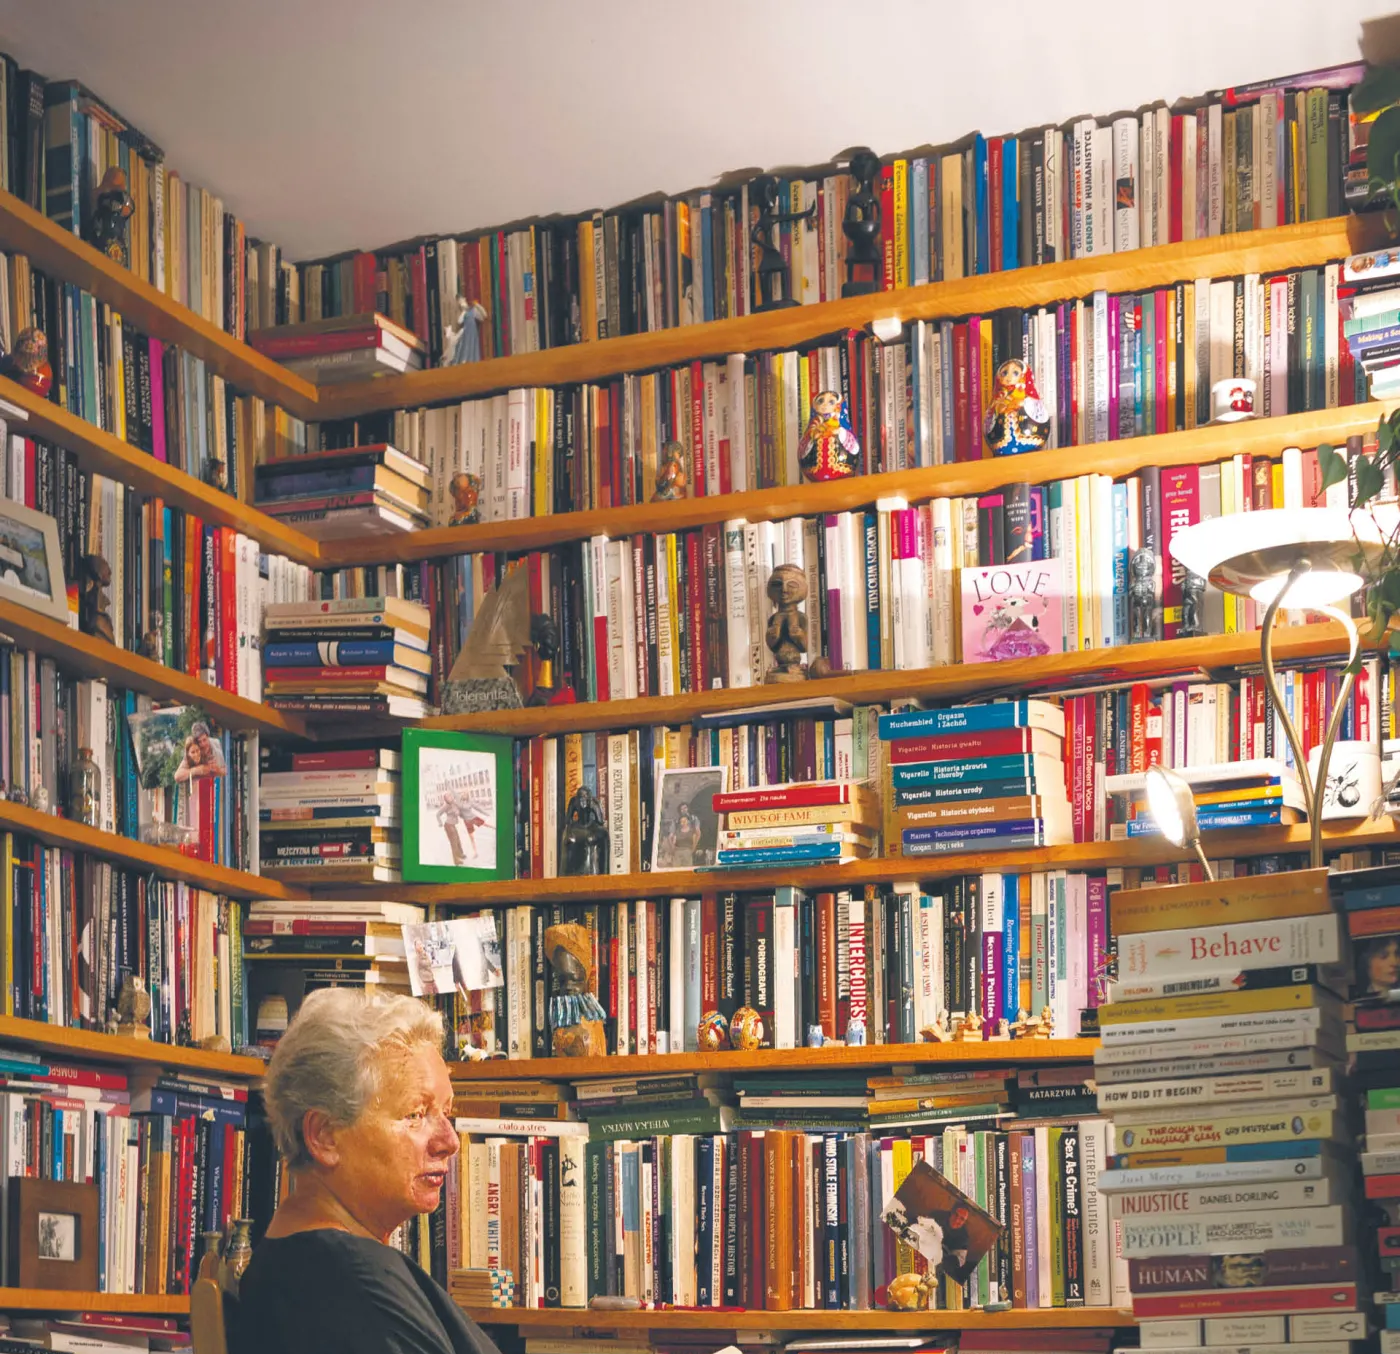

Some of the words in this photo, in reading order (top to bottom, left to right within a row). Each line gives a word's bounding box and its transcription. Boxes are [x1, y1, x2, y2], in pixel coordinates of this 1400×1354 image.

[1084, 130, 1092, 199] HUMANISTYCE
[1085, 202, 1092, 210] W
[1085, 214, 1093, 253] GENDER
[1288, 275, 1296, 305] Zdrowie
[1236, 297, 1244, 320] WOMEN
[1288, 307, 1296, 335] kobiety
[867, 527, 877, 564] WOMEN
[867, 566, 878, 591] WHO
[972, 569, 1050, 602] LOVE
[610, 574, 621, 626] Anatomy
[868, 590, 878, 612] KILL
[659, 602, 670, 657] PEDOFILIA
[613, 644, 622, 673] Love
[890, 718, 933, 728] Muchembled
[938, 713, 965, 721] Orgazm
[942, 719, 967, 728] Zachód
[1134, 703, 1143, 734] WOMEN
[613, 740, 622, 764] STEINEM
[898, 744, 927, 754] Vigarello
[931, 742, 958, 750] Historia
[1086, 736, 1093, 744] In
[1134, 740, 1143, 767] AND
[900, 770, 929, 779] Vigarello
[961, 763, 987, 771] zdrowia
[938, 771, 964, 779] choroby
[1085, 753, 1093, 786] Different
[613, 769, 623, 811] REVOLUTION
[902, 791, 931, 800] Vigarello
[935, 788, 962, 796] Historia
[963, 786, 983, 795] urody
[1085, 788, 1093, 810] Voice
[614, 813, 623, 831] FROM
[733, 813, 765, 825] WIVES
[768, 812, 780, 823] OF
[907, 811, 937, 820] Vigarello
[941, 808, 967, 817] Historia
[1214, 815, 1252, 824] SHOWALTER
[614, 833, 624, 858] WITHIN
[935, 829, 969, 838] Technologia
[837, 891, 849, 940] WOMEN
[987, 891, 995, 926] Millett
[1006, 919, 1014, 953] Rewriting
[1035, 924, 1044, 954] female
[1190, 932, 1282, 961] Behave
[837, 942, 849, 972] WHO
[987, 936, 995, 974] Sexual
[757, 938, 766, 1006] PORNOGRAPHY
[1036, 957, 1044, 991] desires
[987, 977, 996, 1019] Politics
[1029, 1088, 1076, 1100] KATARZYNA
[1105, 1091, 1129, 1102] HOW
[1131, 1090, 1150, 1099] DID
[1153, 1089, 1163, 1099] IT
[1165, 1086, 1203, 1097] BEGIN?
[528, 1123, 547, 1133] stres
[601, 1122, 634, 1134] MATKA
[635, 1119, 670, 1129] WIELKA
[1147, 1126, 1194, 1136] THROUGH
[826, 1138, 837, 1157] WHO
[1065, 1138, 1075, 1158] Sex
[1141, 1135, 1190, 1145] LANGUAGE
[1194, 1131, 1221, 1142] GLASS
[826, 1158, 837, 1181] STOLE
[1066, 1161, 1076, 1174] As
[1085, 1136, 1096, 1186] BUTTERFLY
[1120, 1174, 1144, 1184] Just
[1150, 1172, 1184, 1182] Mercy
[488, 1183, 499, 1216] ANGRY
[826, 1183, 838, 1226] FEMINISM?
[1066, 1176, 1078, 1215] Crime?
[1121, 1192, 1190, 1214] INJUSTICE
[1200, 1195, 1232, 1205] DANIEL
[1235, 1190, 1279, 1203] DORLING
[728, 1204, 736, 1244] EUROPEAN
[1087, 1190, 1098, 1235] POLITICS
[488, 1219, 499, 1252] WHITE
[1125, 1231, 1202, 1250] PEOPLE
[727, 1245, 736, 1277] HISTORY
[1138, 1267, 1208, 1285] HUMAN
